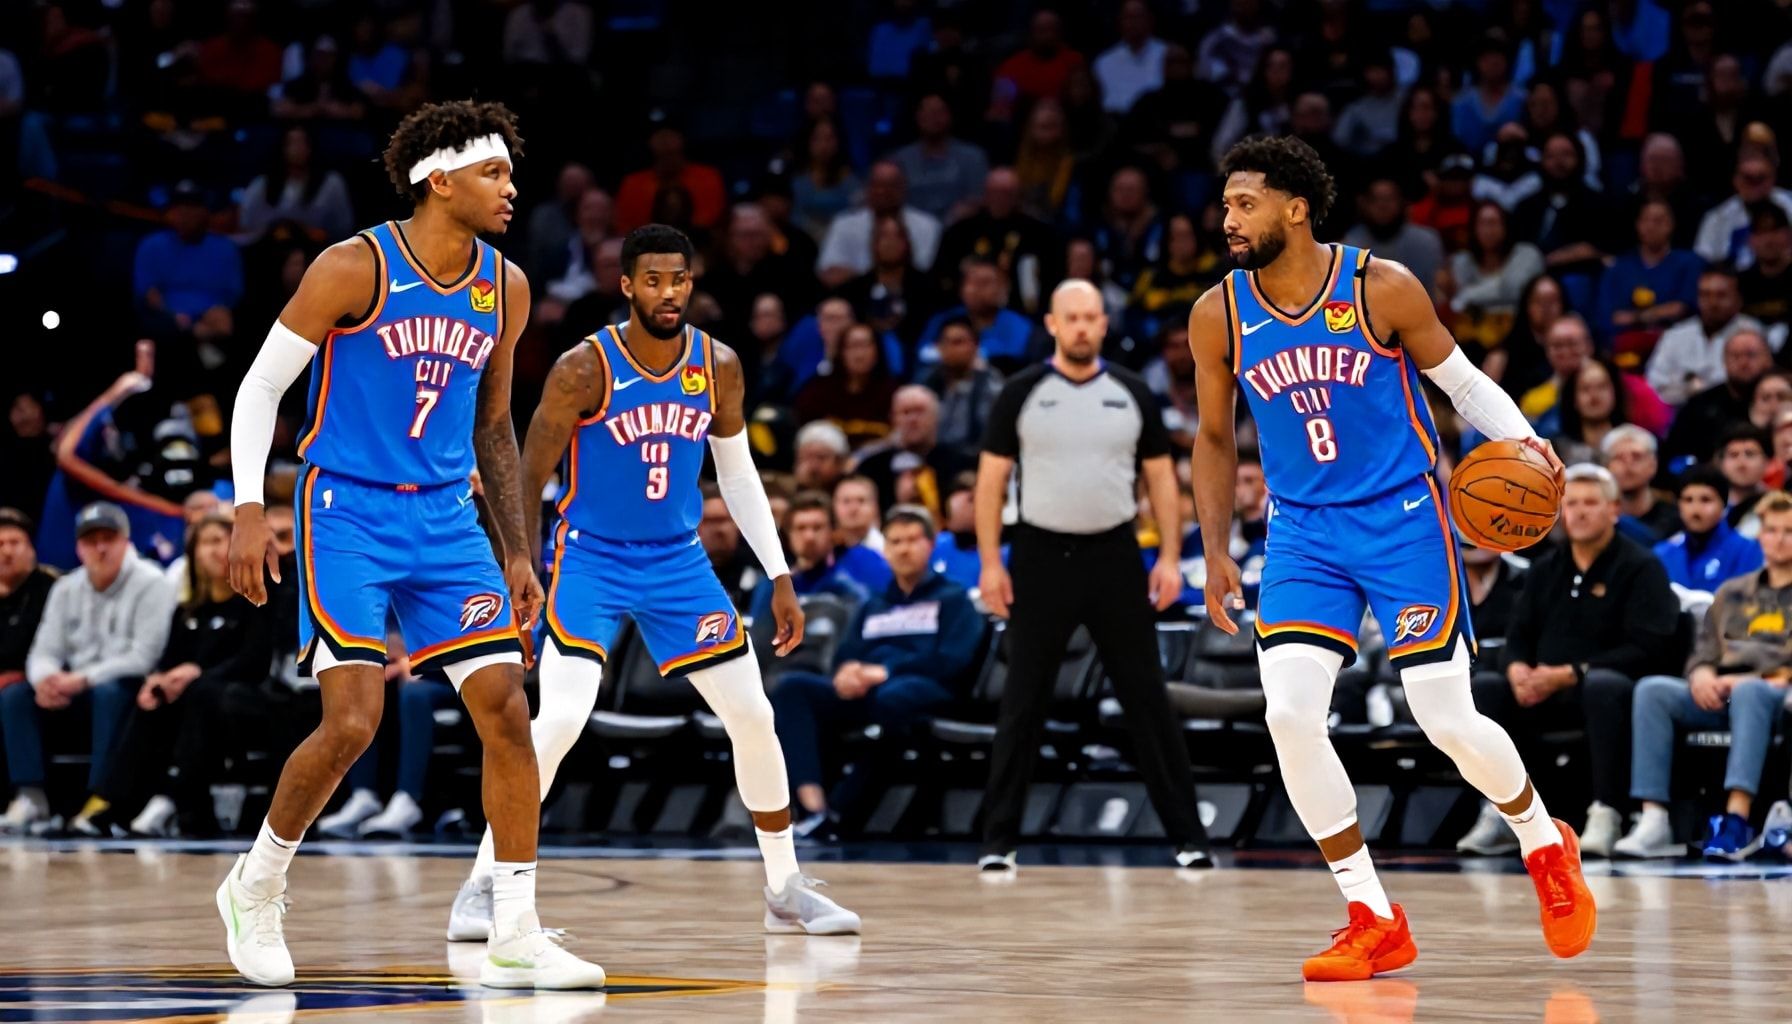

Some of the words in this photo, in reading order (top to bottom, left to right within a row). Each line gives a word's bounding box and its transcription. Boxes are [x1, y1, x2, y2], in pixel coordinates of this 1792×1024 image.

[408, 388, 440, 439] 7
[1304, 417, 1338, 463] 8
[645, 465, 669, 501] 9
